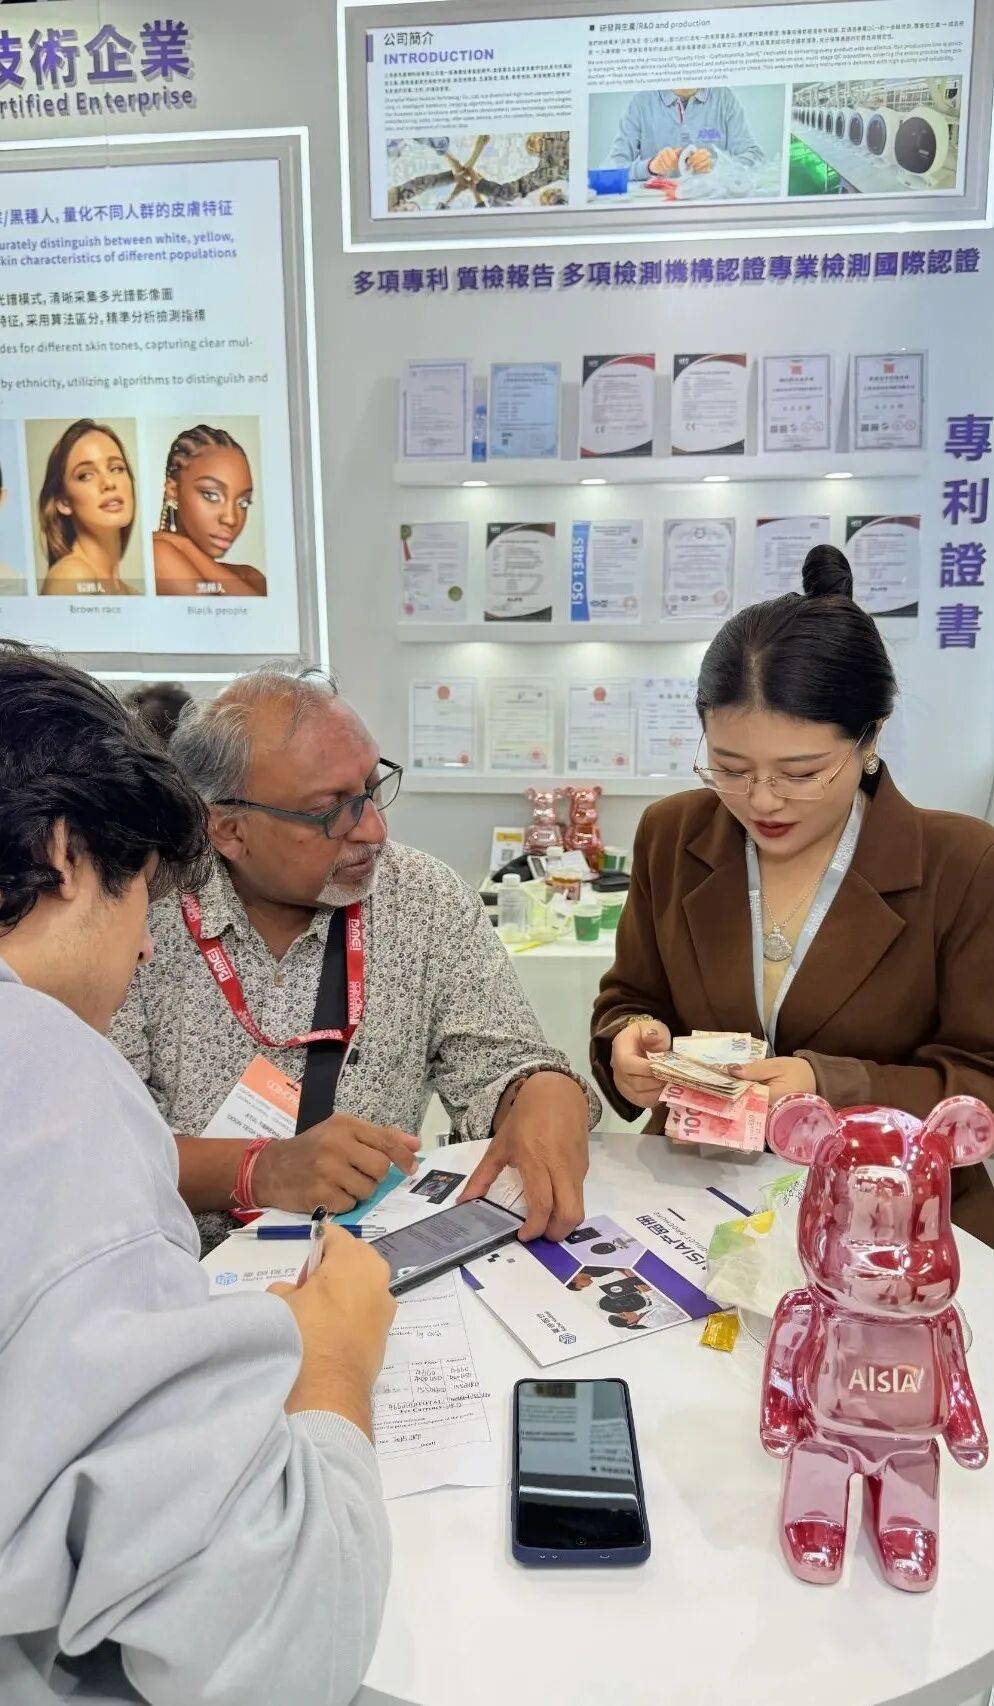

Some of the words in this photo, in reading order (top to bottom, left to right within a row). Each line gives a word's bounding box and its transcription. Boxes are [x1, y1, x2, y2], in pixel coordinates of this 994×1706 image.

[655, 20, 669, 29] and
[671, 19, 711, 30] production
[384, 31, 434, 47] 公司簡介
[0, 20, 189, 87] 技術企業
[384, 49, 494, 65] INTRODUCTION
[76, 86, 193, 111] Enterprise
[40, 236, 101, 250] distinguish
[104, 235, 153, 247] between
[155, 232, 191, 245] white,
[194, 231, 234, 246] yellow,
[20, 253, 101, 266] characteristics
[104, 252, 115, 263] of
[118, 250, 167, 263] different
[169, 247, 237, 263] populations
[354, 266, 449, 295] 多項專利
[457, 263, 555, 291] 質檢報告
[20, 342, 34, 353] for
[37, 341, 83, 353] different
[85, 340, 107, 352] skin
[109, 339, 143, 351] tones,
[145, 338, 197, 352] capturing
[199, 337, 225, 349] clear
[1, 379, 13, 391] by
[16, 377, 66, 391] ethnicity,
[67, 375, 110, 389] utilizing
[113, 374, 170, 388] algorithms
[172, 375, 184, 385] to
[186, 373, 245, 387] distinguish
[247, 372, 269, 384] and
[936, 414, 993, 649] 專利證書
[571, 582, 585, 605] ISO
[848, 1366, 918, 1393] AISIA
